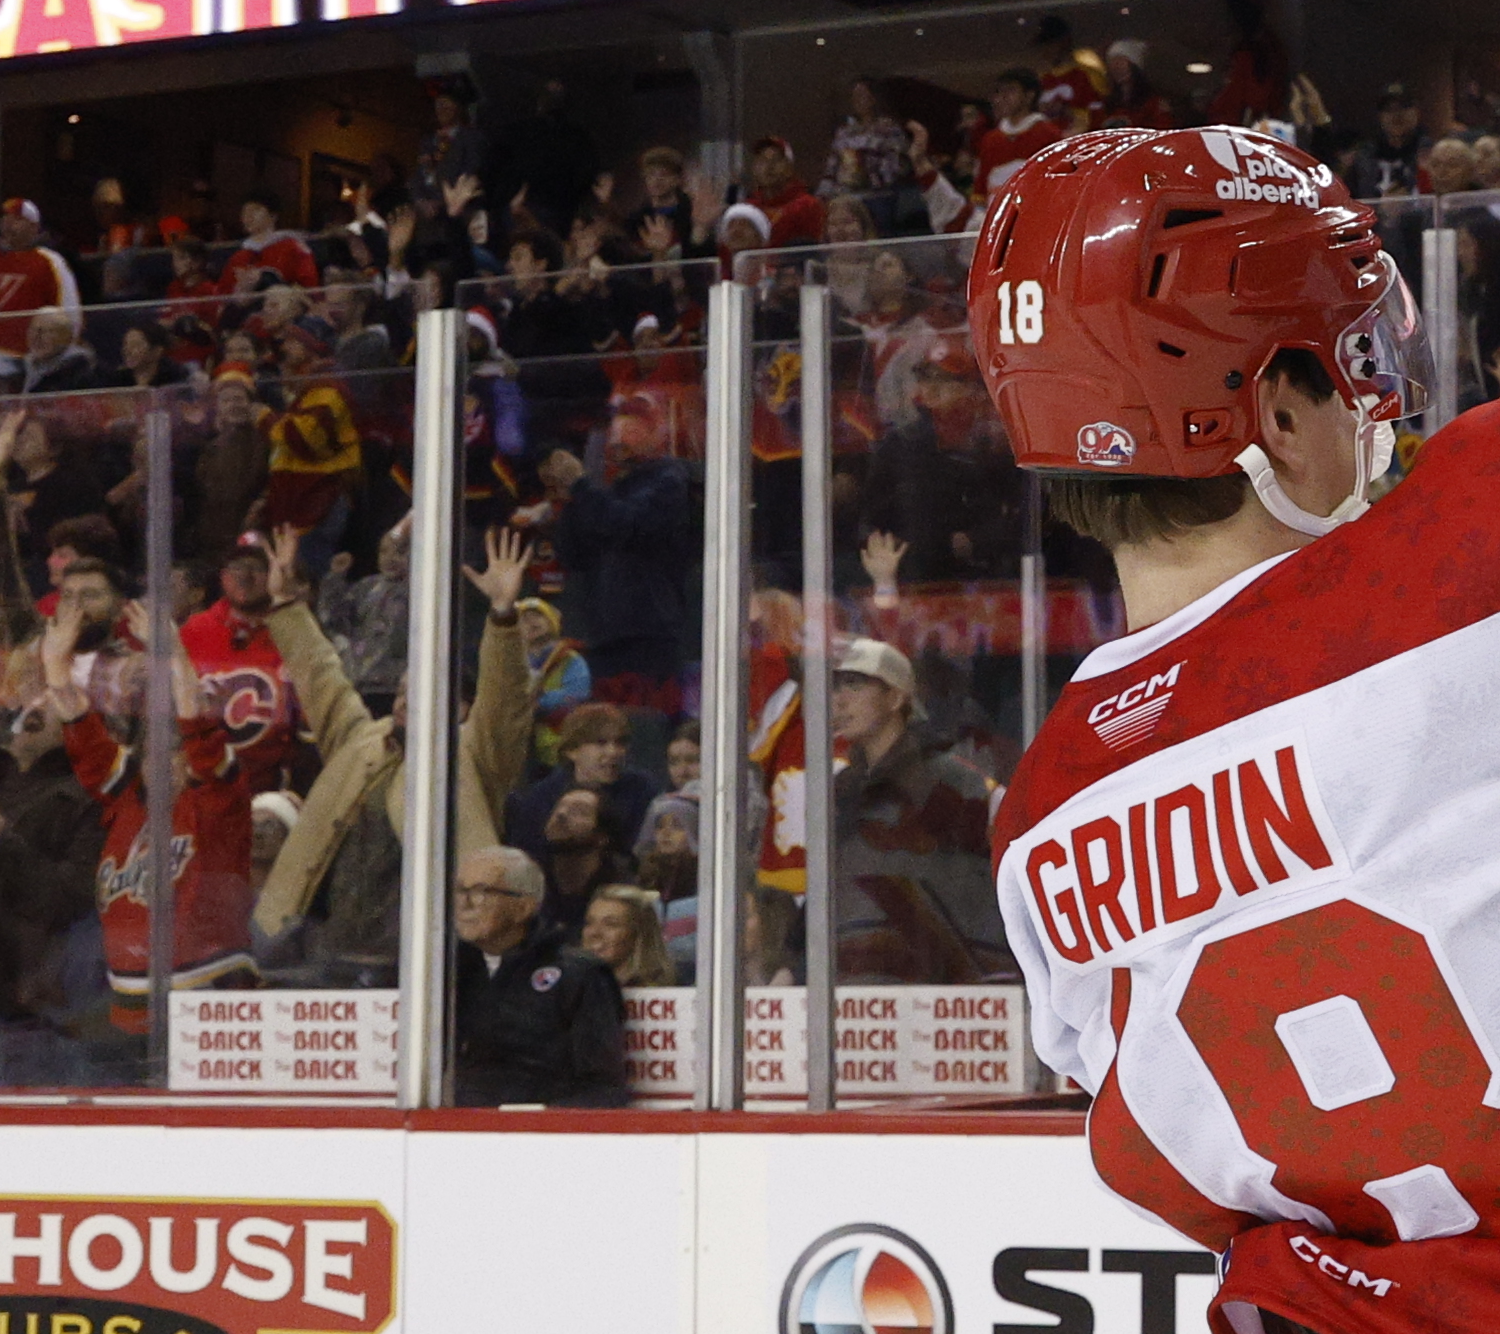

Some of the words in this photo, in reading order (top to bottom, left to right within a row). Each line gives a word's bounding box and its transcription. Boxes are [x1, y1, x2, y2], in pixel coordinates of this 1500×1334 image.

[997, 280, 1045, 346] 18
[1372, 394, 1399, 420] CCM
[1086, 661, 1182, 725] CCM
[1025, 744, 1333, 965] GRIDIN
[199, 1001, 263, 1021] BRICK
[294, 1001, 358, 1021] BRICK
[624, 999, 676, 1020] RICK
[745, 999, 784, 1020] ICK
[934, 999, 1009, 1020] BRICK
[199, 1031, 263, 1051] BRICK
[294, 1031, 358, 1051] BRICK
[624, 1030, 676, 1051] RICK
[745, 1030, 784, 1051] ICK
[934, 1030, 1009, 1051] BRICK
[199, 1060, 263, 1080] BRICK
[294, 1060, 358, 1080] BRICK
[624, 1061, 676, 1082] RICK
[745, 1061, 784, 1082] ICK
[934, 1061, 1009, 1082] BRICK
[1288, 1234, 1394, 1299] CCM
